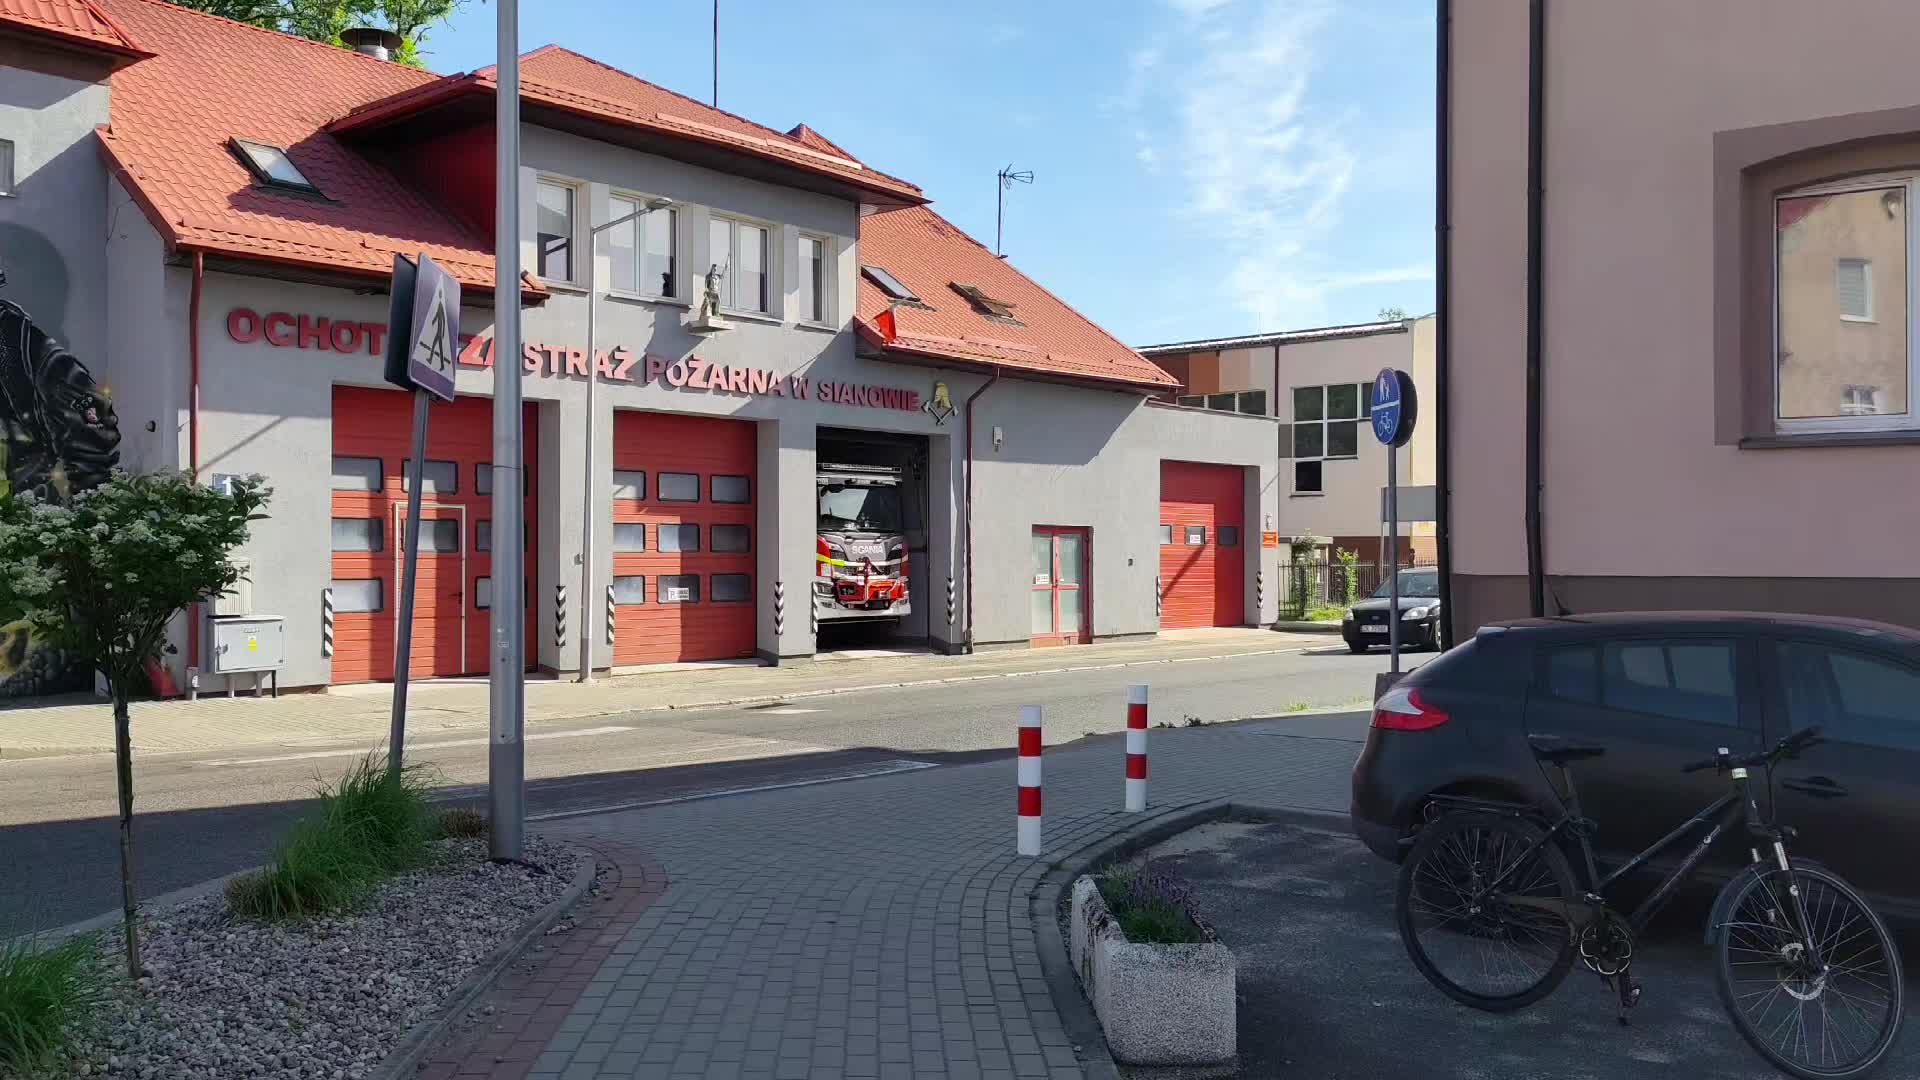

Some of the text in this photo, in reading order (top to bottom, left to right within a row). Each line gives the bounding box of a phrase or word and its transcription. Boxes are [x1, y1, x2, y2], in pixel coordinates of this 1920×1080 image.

[522, 343, 635, 381] STRAŻ
[646, 353, 784, 396] POŻARNA
[792, 375, 809, 400] W
[818, 381, 920, 411] SIANOWIE
[852, 545, 884, 554] SCANIA
